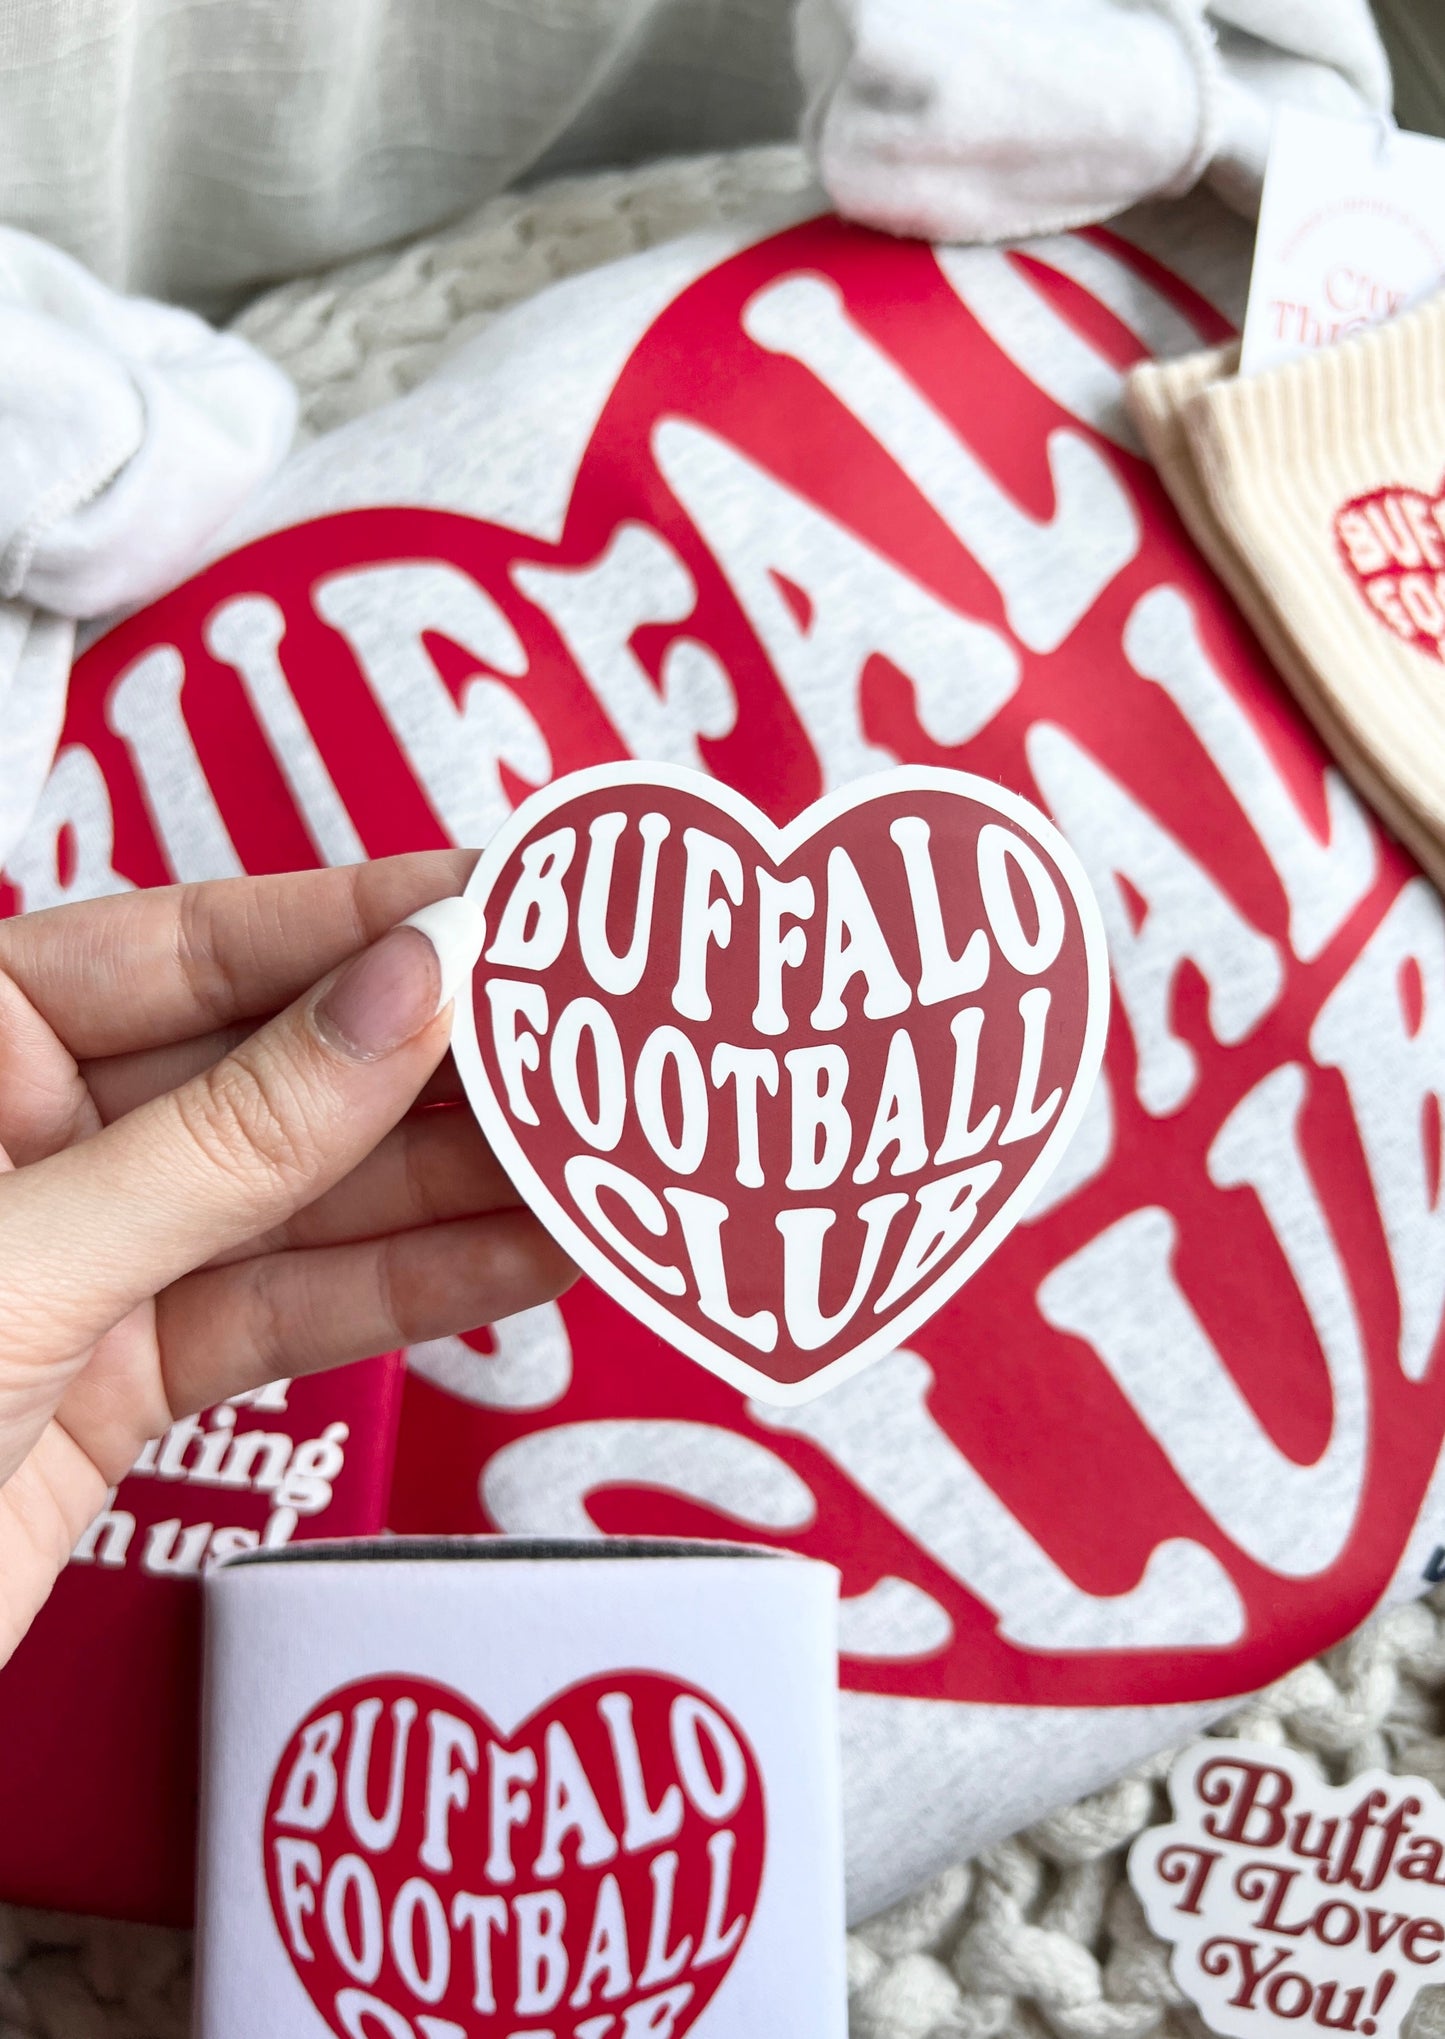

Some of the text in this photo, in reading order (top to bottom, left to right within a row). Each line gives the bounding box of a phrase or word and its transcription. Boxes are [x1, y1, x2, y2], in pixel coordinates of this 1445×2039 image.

[485, 811, 1065, 1036] BUFFALO
[485, 987, 1063, 1190] FOOTBALL
[564, 1154, 1002, 1353] CLUB
[273, 1691, 747, 1883] BUFFALO
[1195, 1755, 1445, 1892] Buffa
[272, 1829, 748, 2016] FOOTBALL
[1156, 1843, 1445, 1965] I Love
[1200, 1935, 1397, 2037] You!
